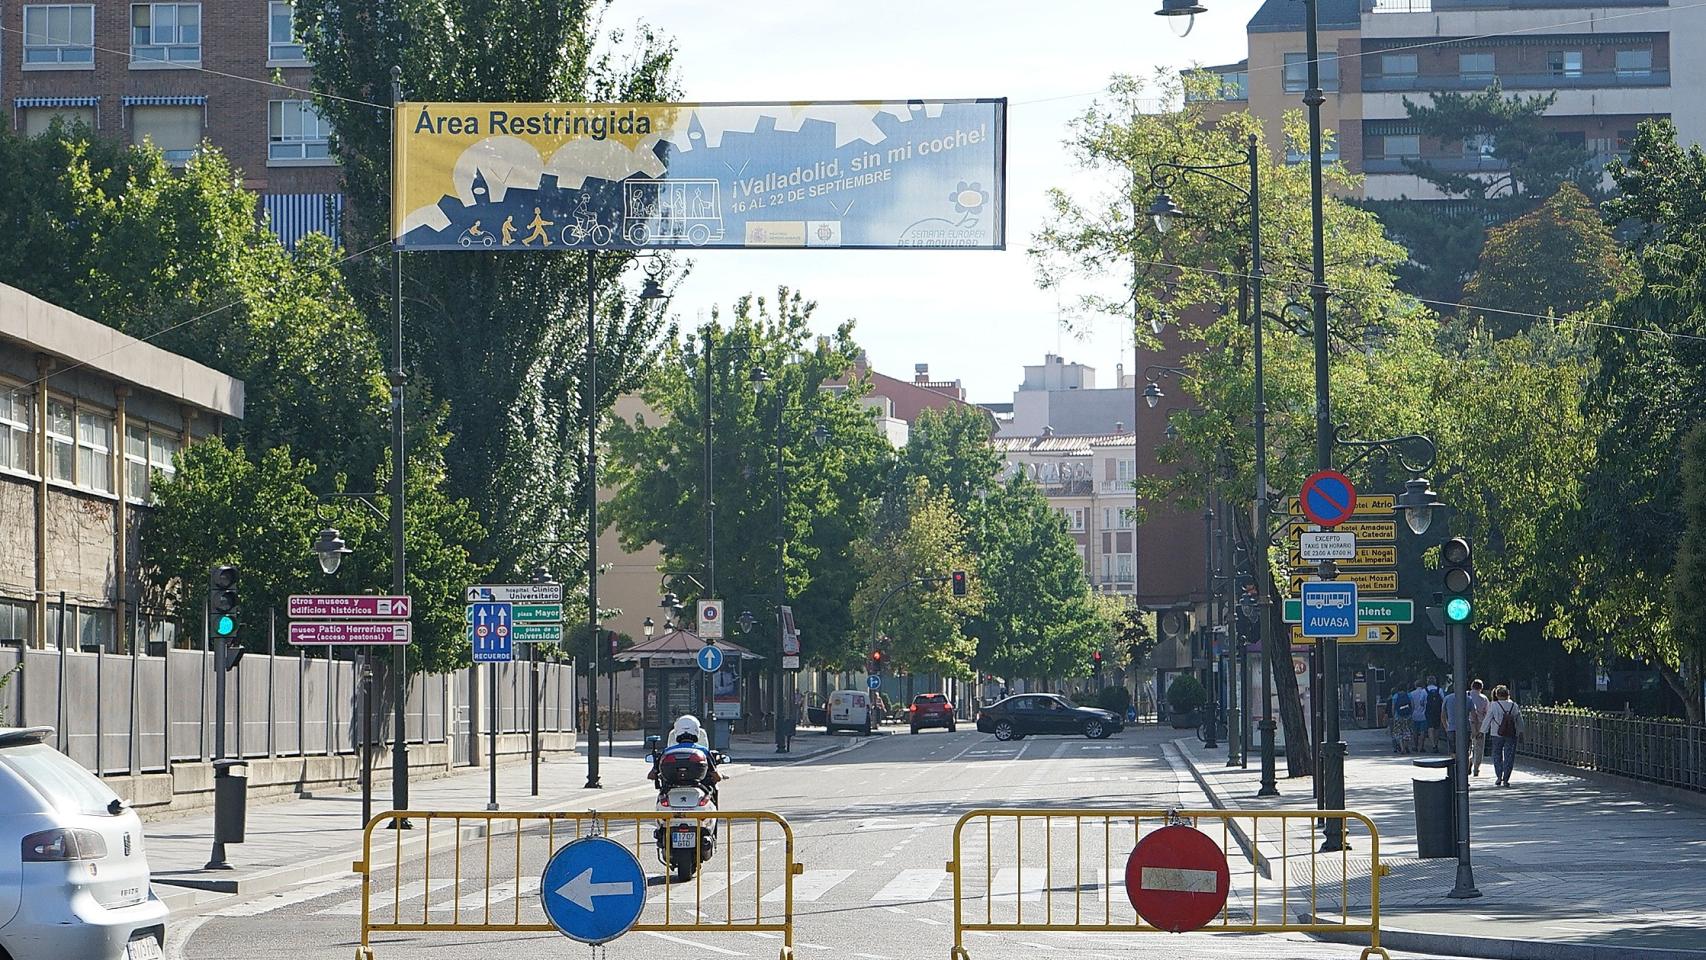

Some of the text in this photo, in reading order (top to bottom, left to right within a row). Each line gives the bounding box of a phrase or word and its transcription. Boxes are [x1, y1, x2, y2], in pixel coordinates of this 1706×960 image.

[414, 104, 652, 142] Área Restringida
[849, 149, 881, 175] sin
[887, 140, 911, 163] mi
[917, 122, 987, 156] coche!
[731, 168, 892, 214] 16 AL 22 DE SEPTIEMBRE
[1371, 499, 1393, 508] Atrio
[1360, 523, 1393, 531] Amadeus
[1371, 549, 1393, 558] Nogal
[1364, 556, 1393, 564] Imperial
[1369, 574, 1394, 582] Mozart
[291, 606, 372, 614] edificios históricos
[535, 609, 559, 618] Mayor
[1358, 608, 1392, 616] niente
[1310, 618, 1349, 627] AUVASA
[318, 625, 342, 633] Patio
[345, 625, 393, 633] Herreriano
[349, 632, 386, 641] peatonal)
[513, 632, 560, 640] Universidad
